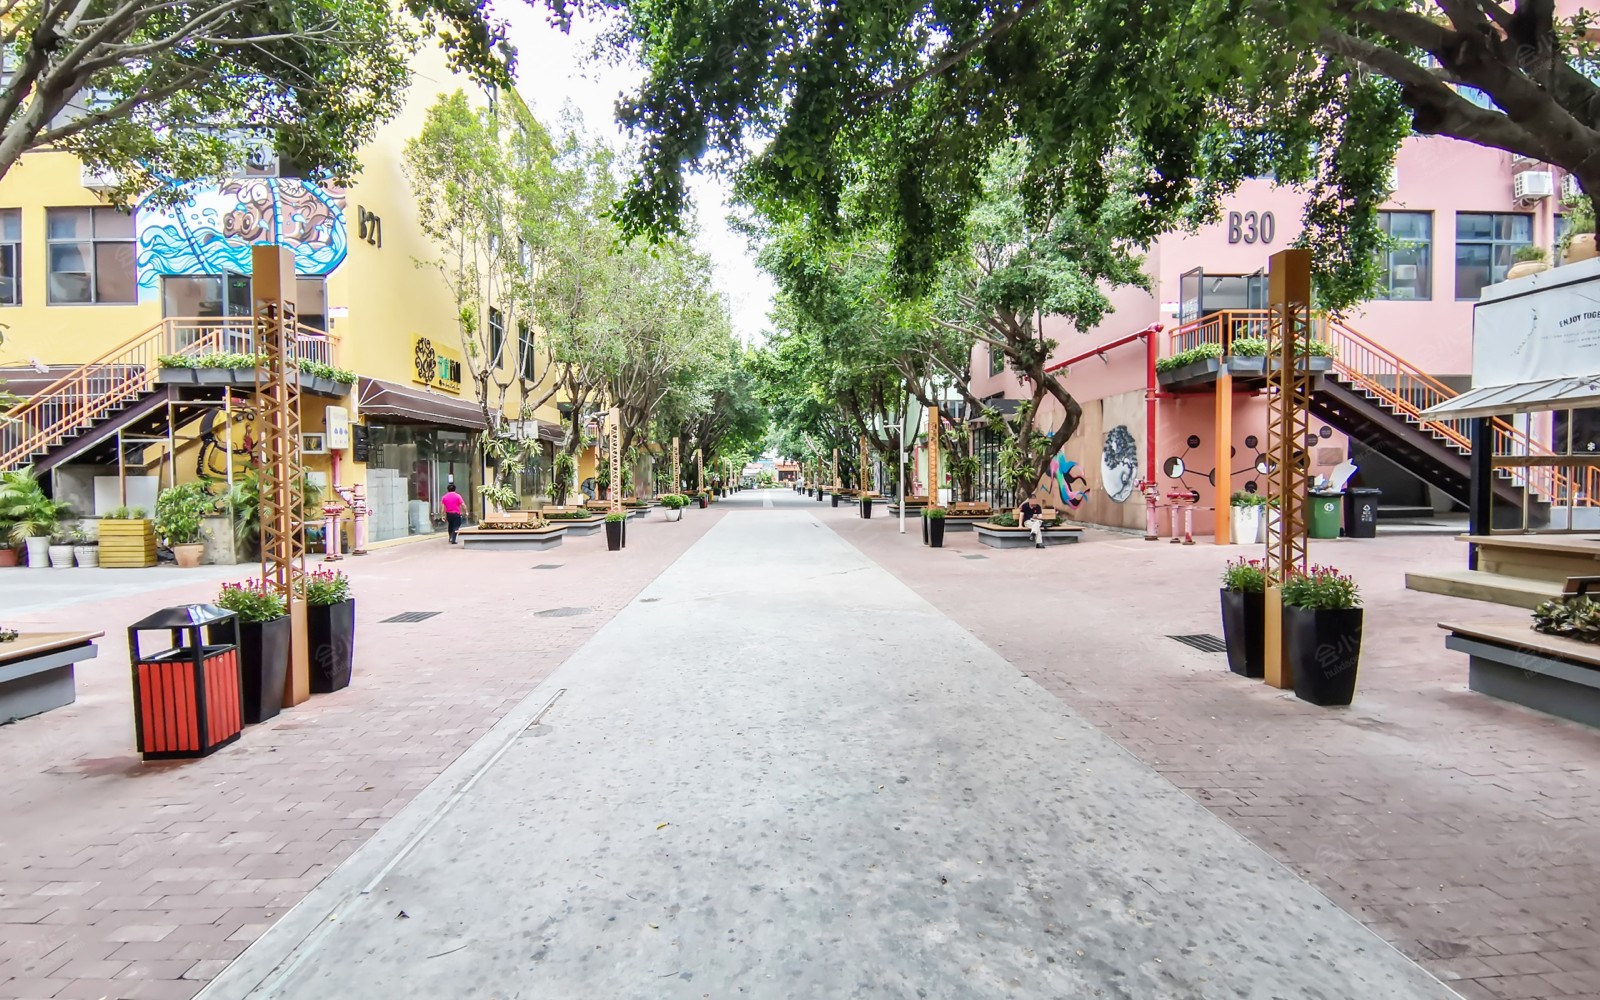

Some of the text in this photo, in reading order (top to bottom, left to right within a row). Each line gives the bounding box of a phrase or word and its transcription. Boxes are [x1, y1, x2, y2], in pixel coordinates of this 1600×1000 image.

[358, 205, 381, 248] B21
[1228, 211, 1275, 244] B30
[1559, 314, 1581, 327] ENJOY
